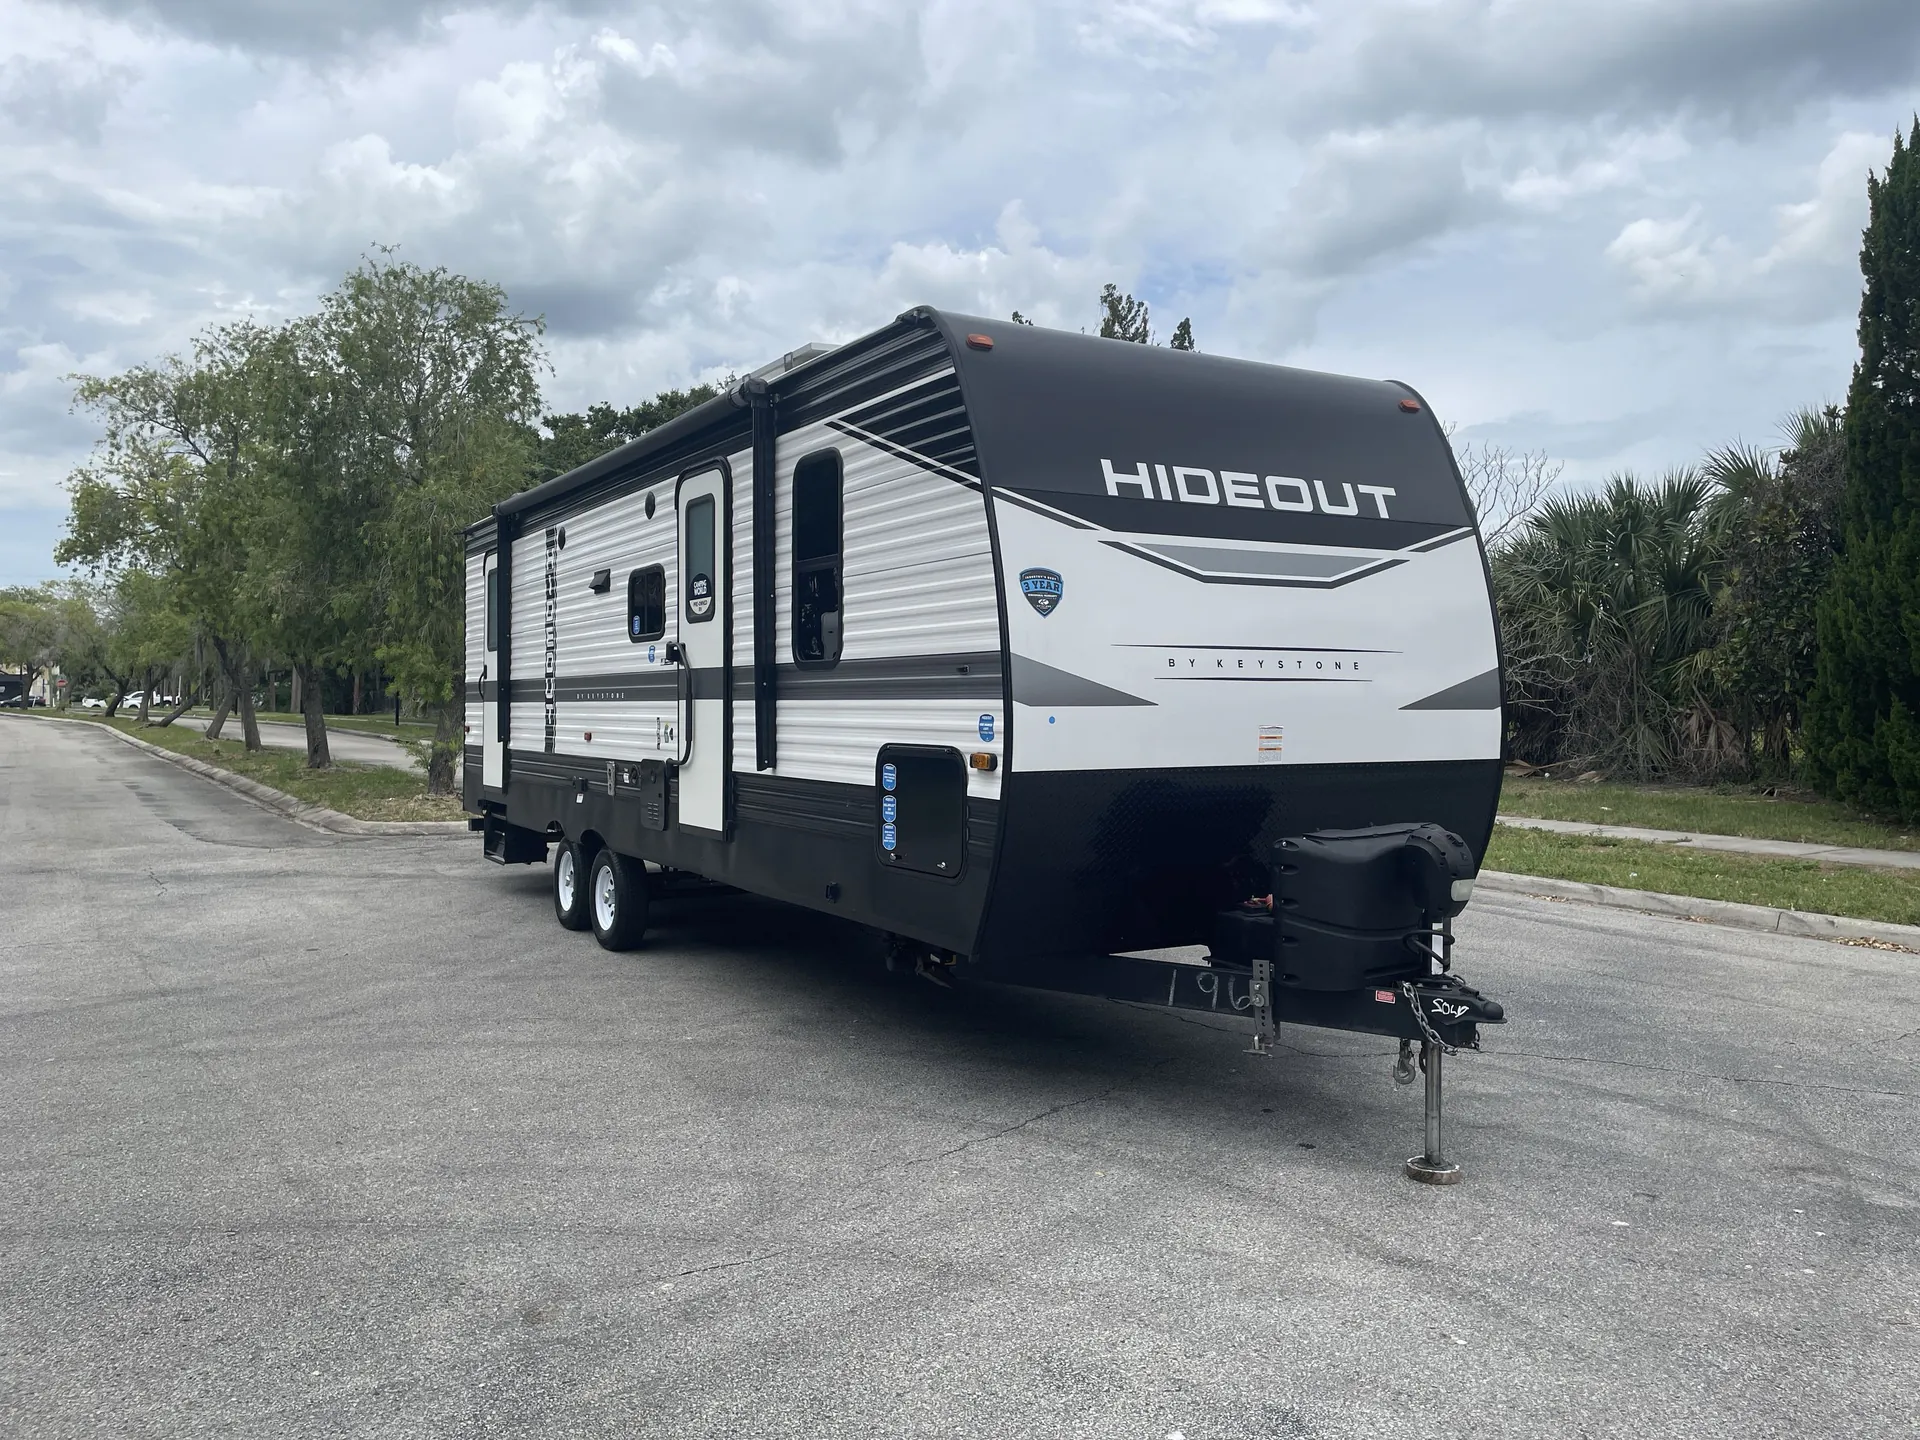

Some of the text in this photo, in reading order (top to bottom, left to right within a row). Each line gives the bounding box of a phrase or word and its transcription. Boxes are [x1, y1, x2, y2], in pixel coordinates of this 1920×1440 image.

[1100, 458, 1397, 519] HIDEOUT
[1023, 580, 1060, 592] 3 YEAR
[545, 548, 555, 725] HIDEOUT
[1168, 658, 1360, 670] BY KEYSTONE
[1431, 998, 1470, 1018] SOLD
